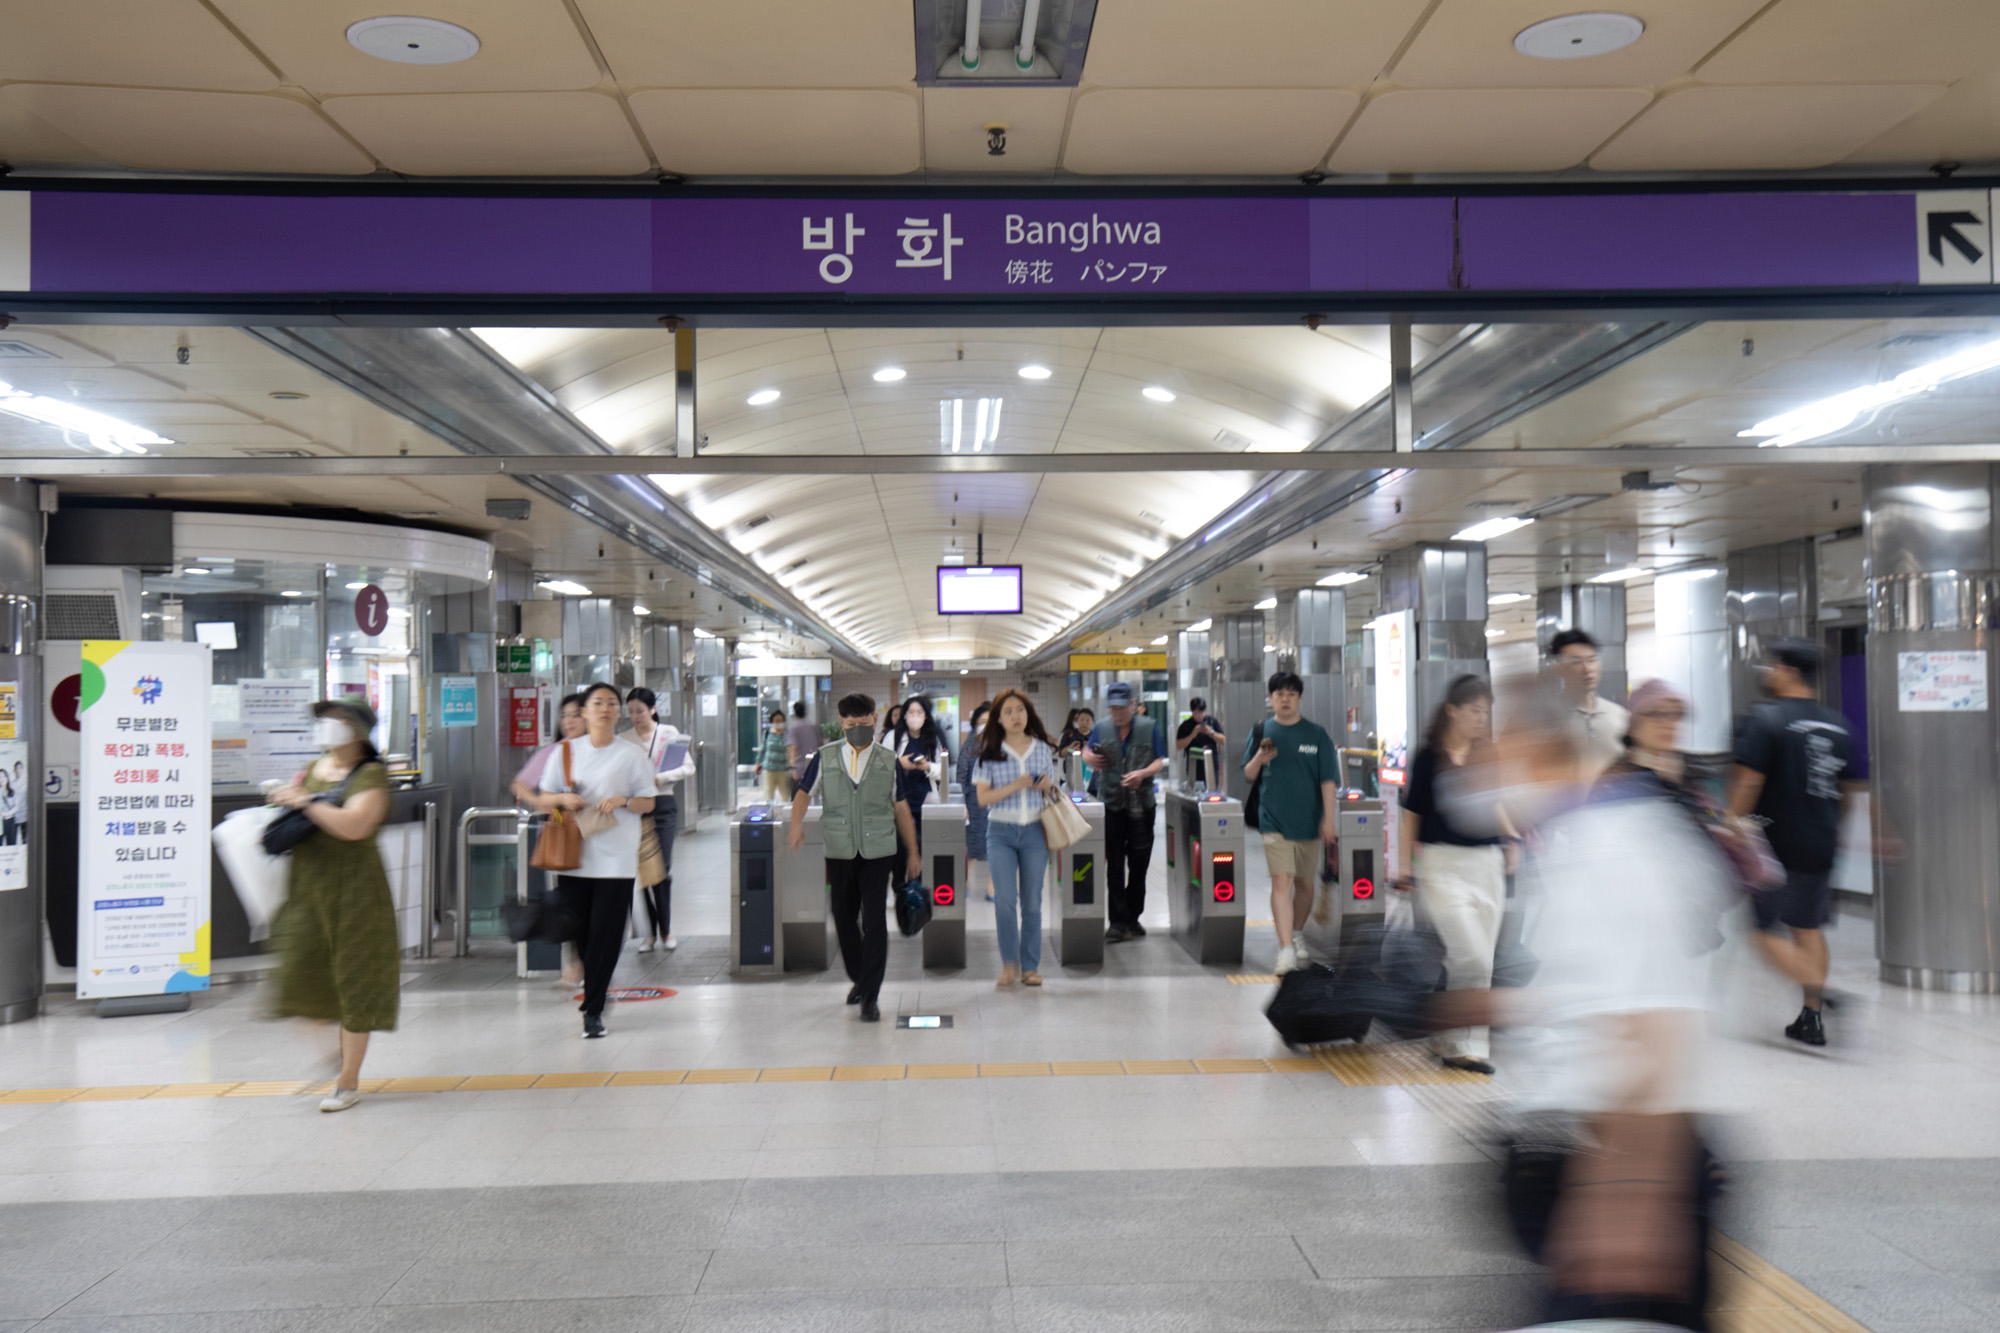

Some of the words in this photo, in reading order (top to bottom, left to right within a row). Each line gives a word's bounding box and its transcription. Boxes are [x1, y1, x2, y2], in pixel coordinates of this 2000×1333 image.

[1004, 213, 1161, 253] Banghwa
[802, 212, 866, 284] 방
[895, 213, 964, 281] 화
[1004, 259, 1054, 284] 傍花
[1080, 259, 1168, 284] パンファ
[116, 717, 178, 732] 무분별한
[104, 743, 150, 758] 폭언과
[155, 743, 189, 758] 폭행,
[113, 769, 159, 784] 성희롱
[165, 769, 180, 783] 시
[98, 795, 160, 811] 관련법에
[164, 794, 195, 809] 따라
[105, 820, 167, 836] 처벌받을
[172, 820, 187, 835] 수
[115, 846, 177, 862] 있습니다
